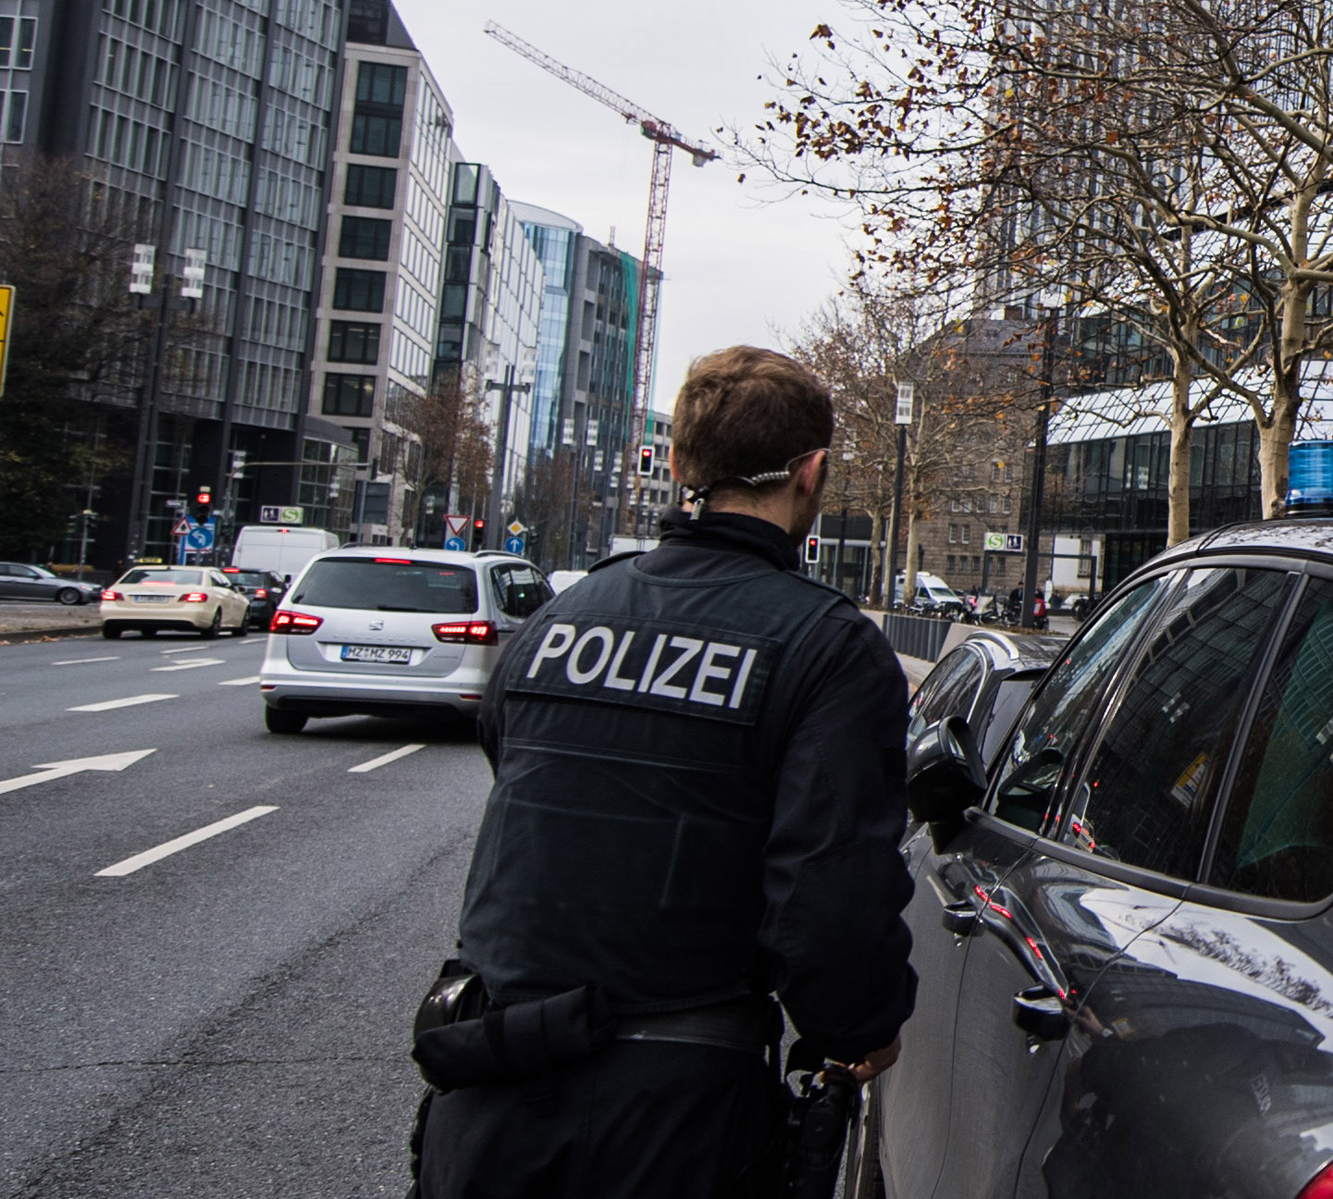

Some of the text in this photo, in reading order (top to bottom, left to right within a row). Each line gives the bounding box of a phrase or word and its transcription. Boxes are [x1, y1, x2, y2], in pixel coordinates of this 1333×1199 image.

[988, 534, 1003, 549] S
[348, 647, 409, 659] MZ MZ 994
[526, 623, 758, 709] POLIZEI
